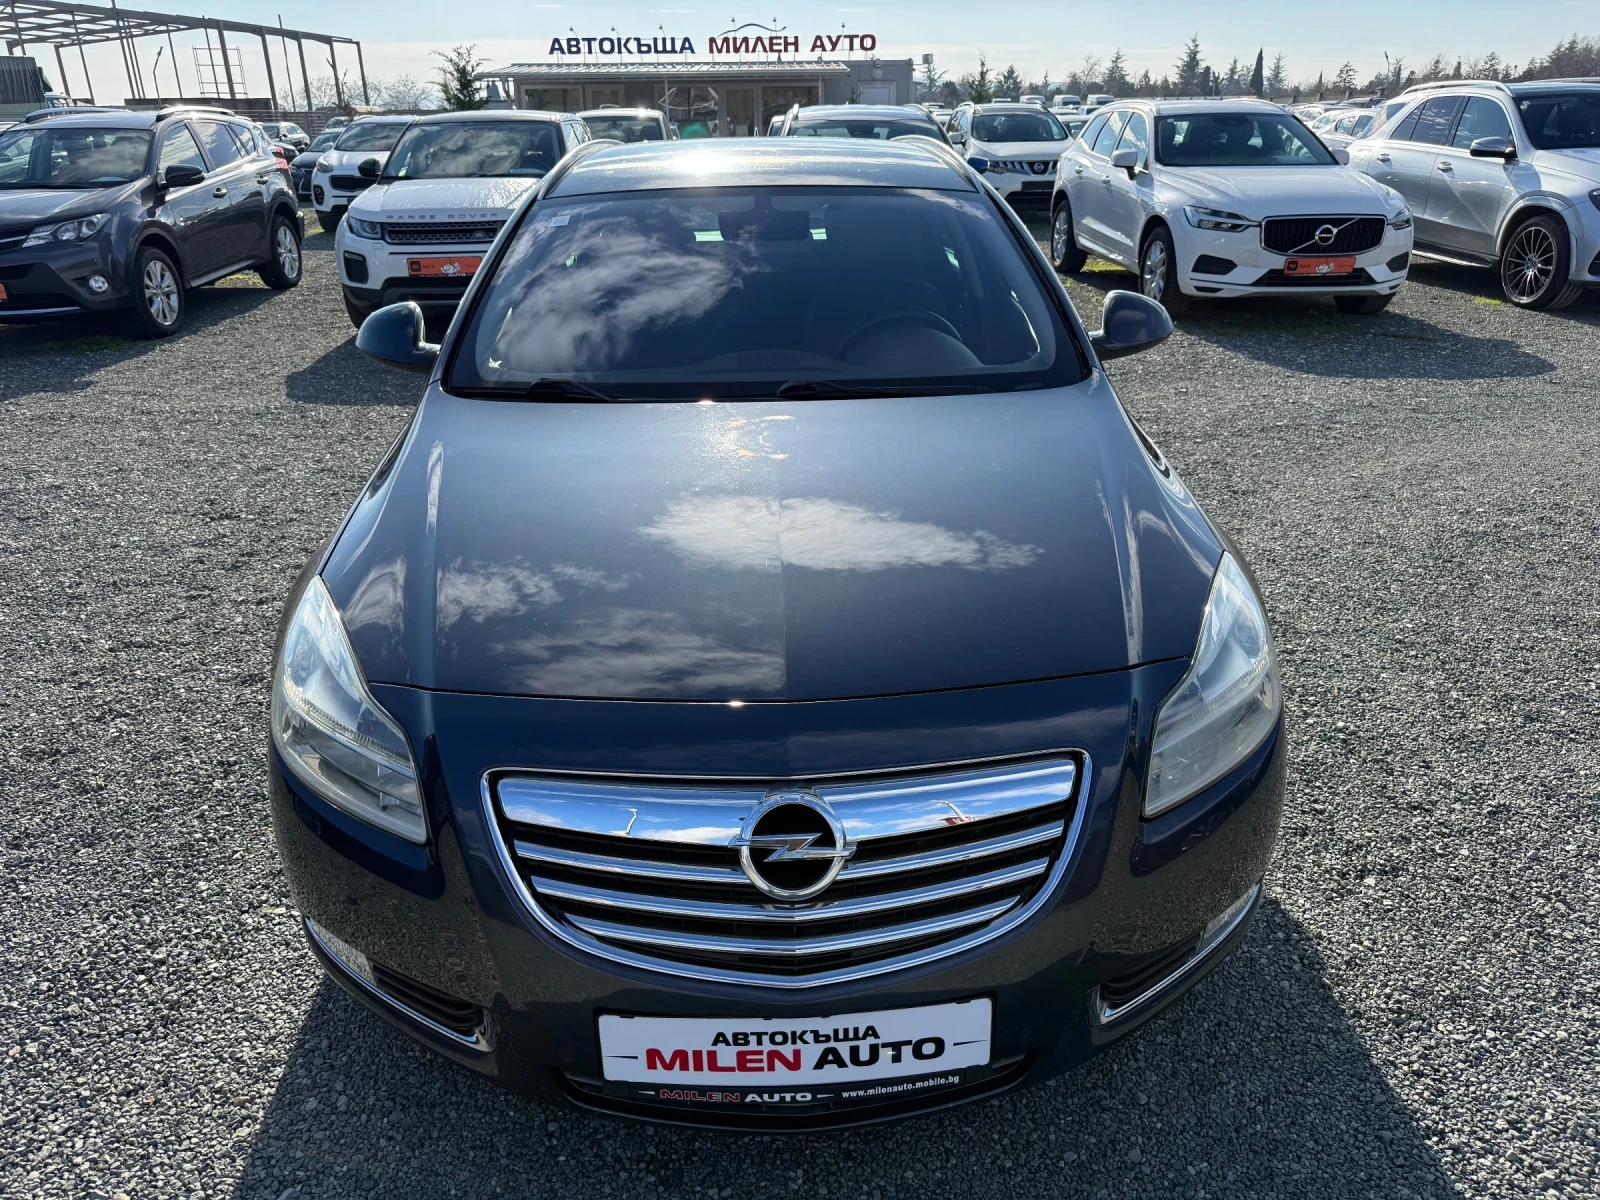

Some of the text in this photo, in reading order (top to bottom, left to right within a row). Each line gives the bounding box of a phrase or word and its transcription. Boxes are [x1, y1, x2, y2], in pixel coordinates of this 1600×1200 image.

[708, 35, 800, 54] МИЛЕН
[810, 33, 877, 52] АУТО
[645, 1036, 946, 1073] MILEN AUTO
[659, 1088, 813, 1103] MILEN AUTO
[841, 1074, 960, 1099] www.milenauto.mobile.bg
